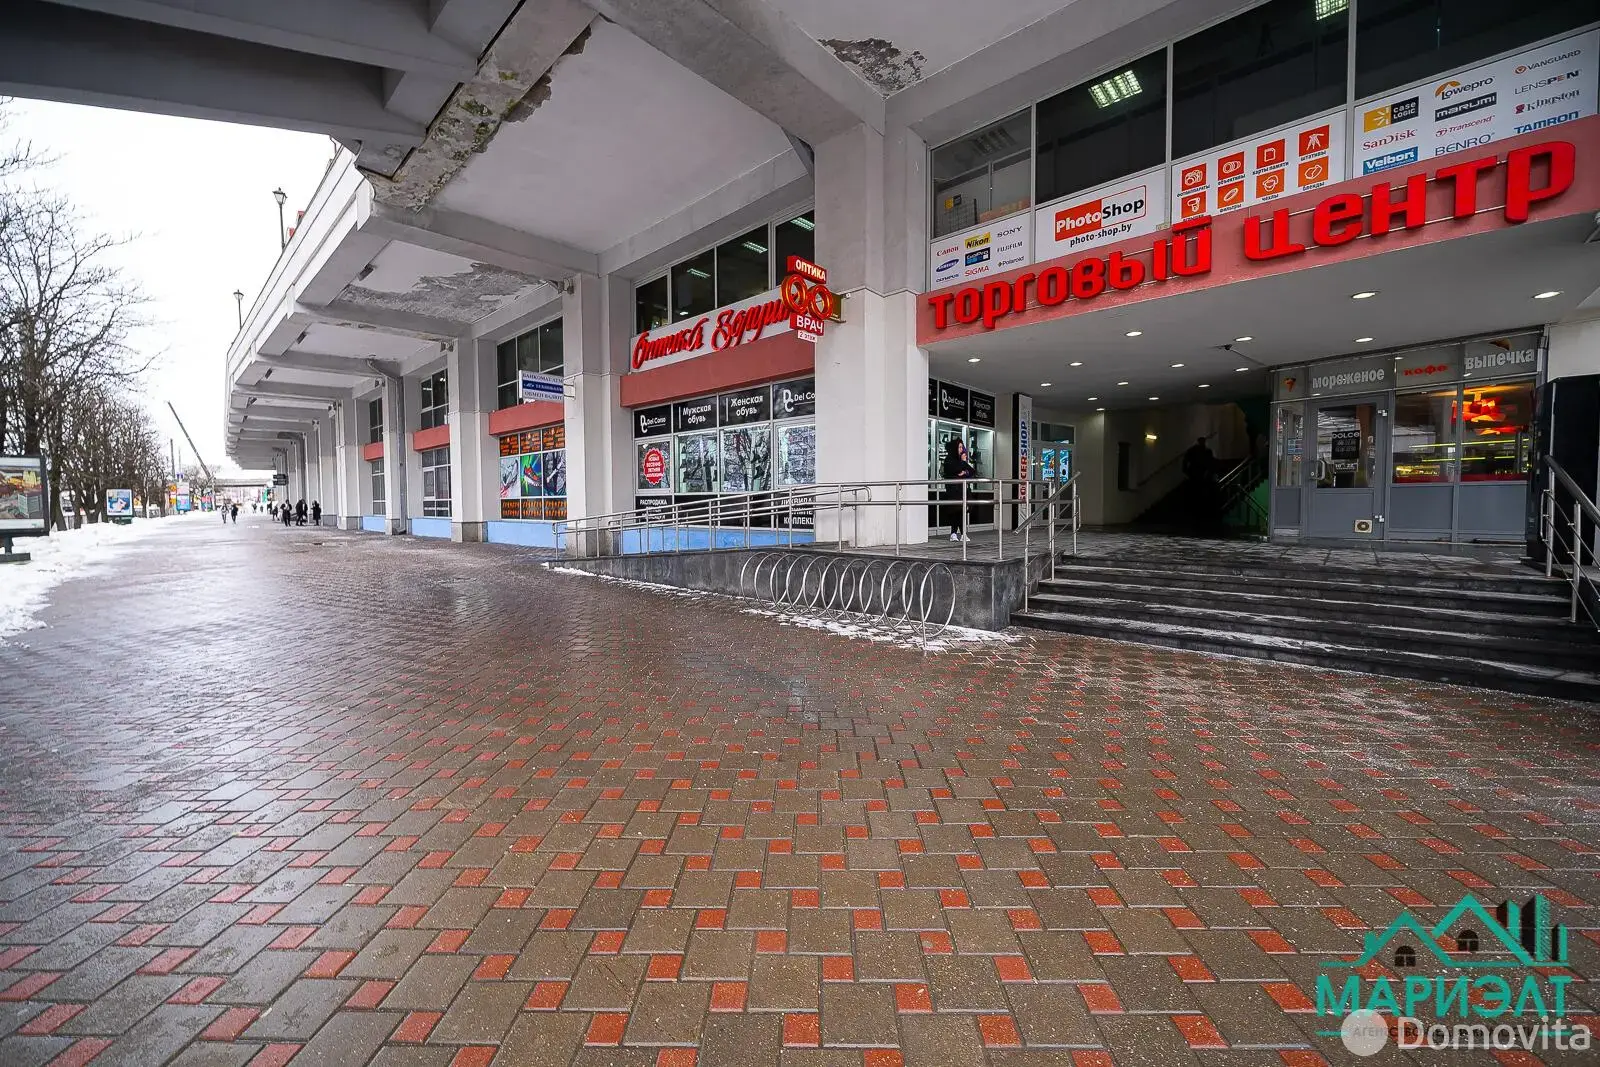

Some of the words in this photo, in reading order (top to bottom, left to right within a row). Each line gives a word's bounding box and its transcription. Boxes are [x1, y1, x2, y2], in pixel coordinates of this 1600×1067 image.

[1527, 49, 1581, 70] VANGUARD
[1441, 76, 1494, 100] Lowepro
[1514, 70, 1579, 95] LENSPEN
[1527, 89, 1580, 112] Kingston
[1393, 108, 1416, 120] LOGIC
[1514, 111, 1579, 134] TAMRON
[1448, 116, 1493, 133] Transcend
[1362, 129, 1416, 151] SanDisk
[1435, 134, 1492, 156] BENRO
[1366, 151, 1415, 170] Velbon
[1056, 199, 1145, 233] PhotoShop
[928, 215, 1212, 330] торговый
[1244, 141, 1576, 261] центр
[997, 226, 1023, 238] SONY
[1070, 223, 1132, 247] photo-shop.by
[936, 246, 959, 257] Canon
[966, 237, 989, 249] Nikon
[997, 241, 1023, 253] FUJIFILM
[795, 259, 826, 281] ОПТИКА
[1002, 255, 1025, 266] Polaroid
[965, 265, 989, 277] SIGMA
[796, 314, 823, 334] ВРАЧ
[1465, 349, 1535, 370] выпечка
[1312, 368, 1385, 390] мороженое
[1404, 364, 1448, 376] кофе
[682, 404, 712, 416] Мужская
[731, 395, 763, 408] Женская
[687, 415, 706, 424] обувь
[736, 406, 758, 417] обувь
